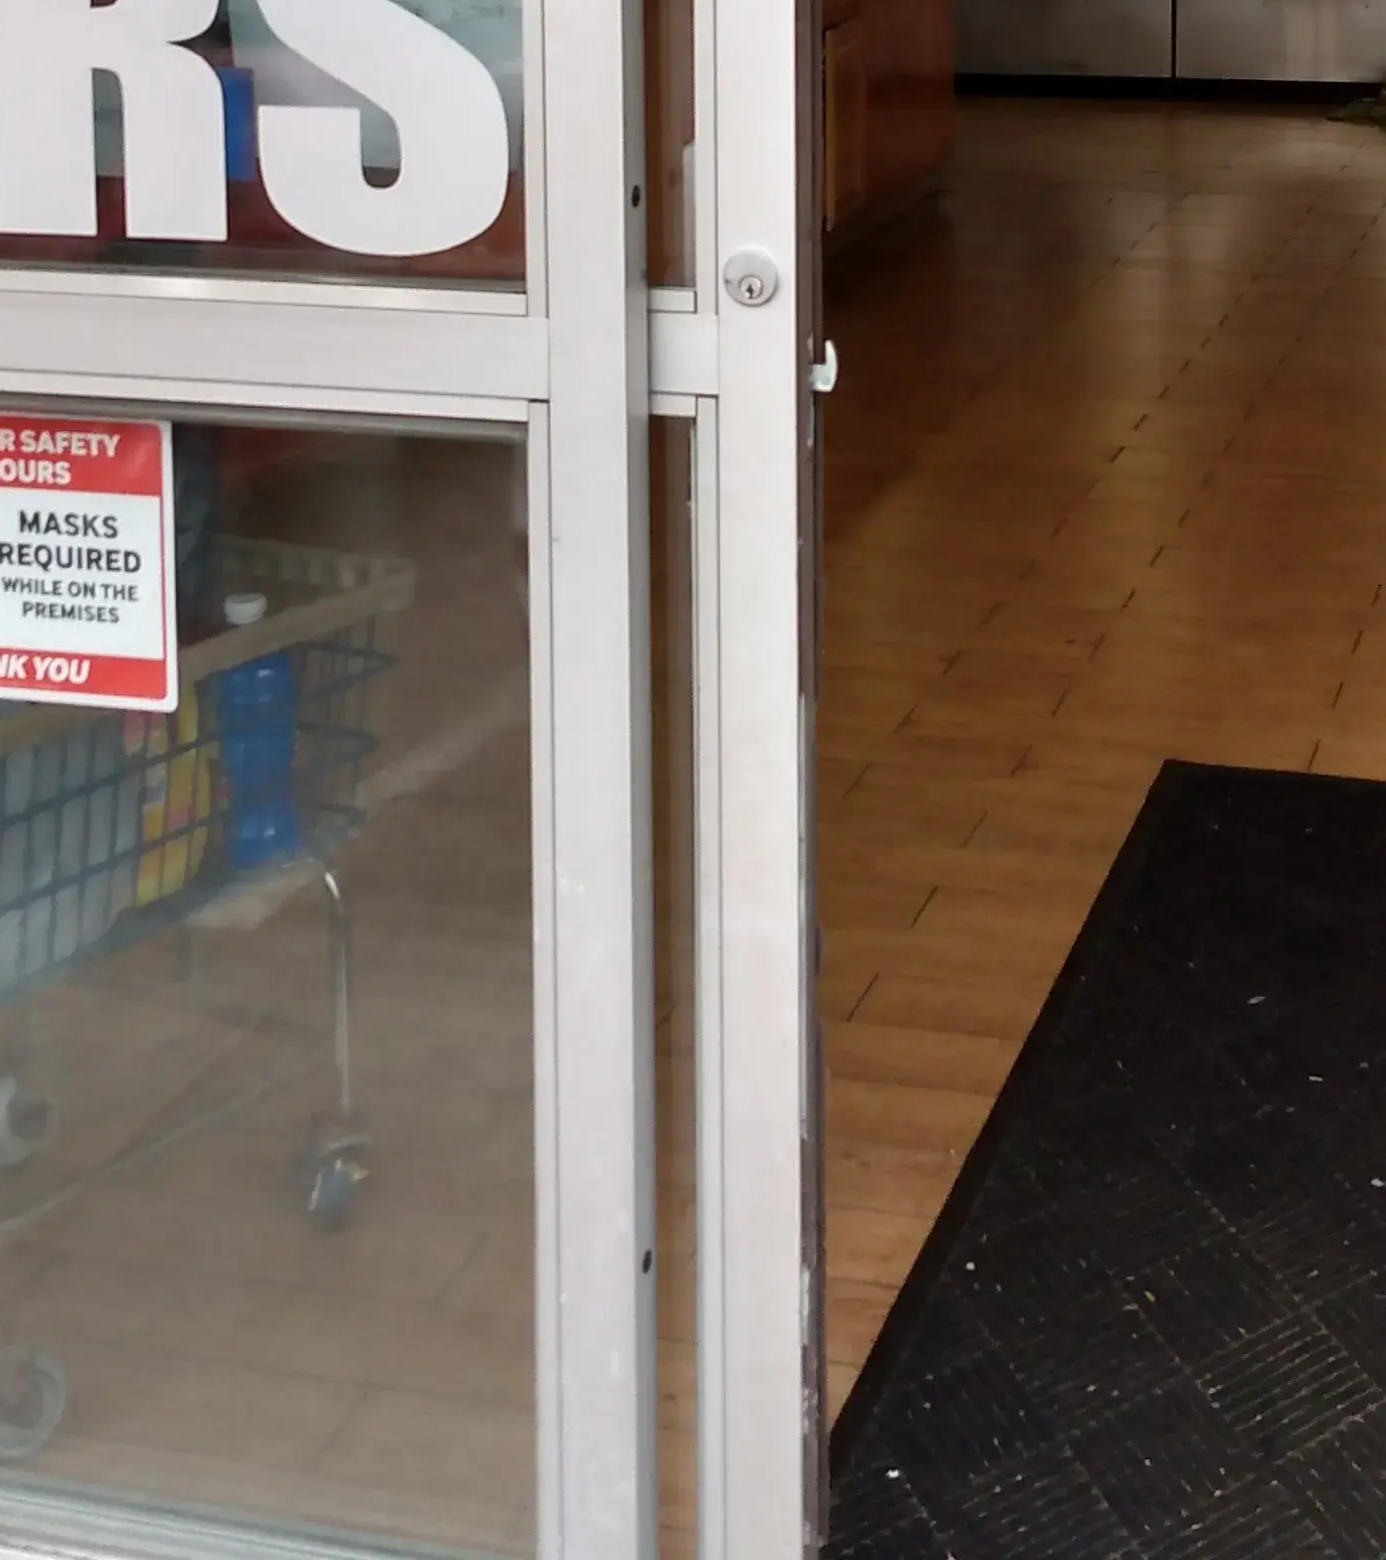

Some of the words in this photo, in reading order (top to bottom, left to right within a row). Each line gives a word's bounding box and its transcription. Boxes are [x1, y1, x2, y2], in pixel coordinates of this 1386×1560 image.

[20, 429, 120, 457] SAFETY
[18, 510, 119, 539] MASKS
[1, 576, 62, 597] WHILE
[67, 580, 96, 599] ON
[100, 583, 139, 602] THE
[22, 602, 119, 624] PREMISES
[33, 656, 90, 684] YOU
